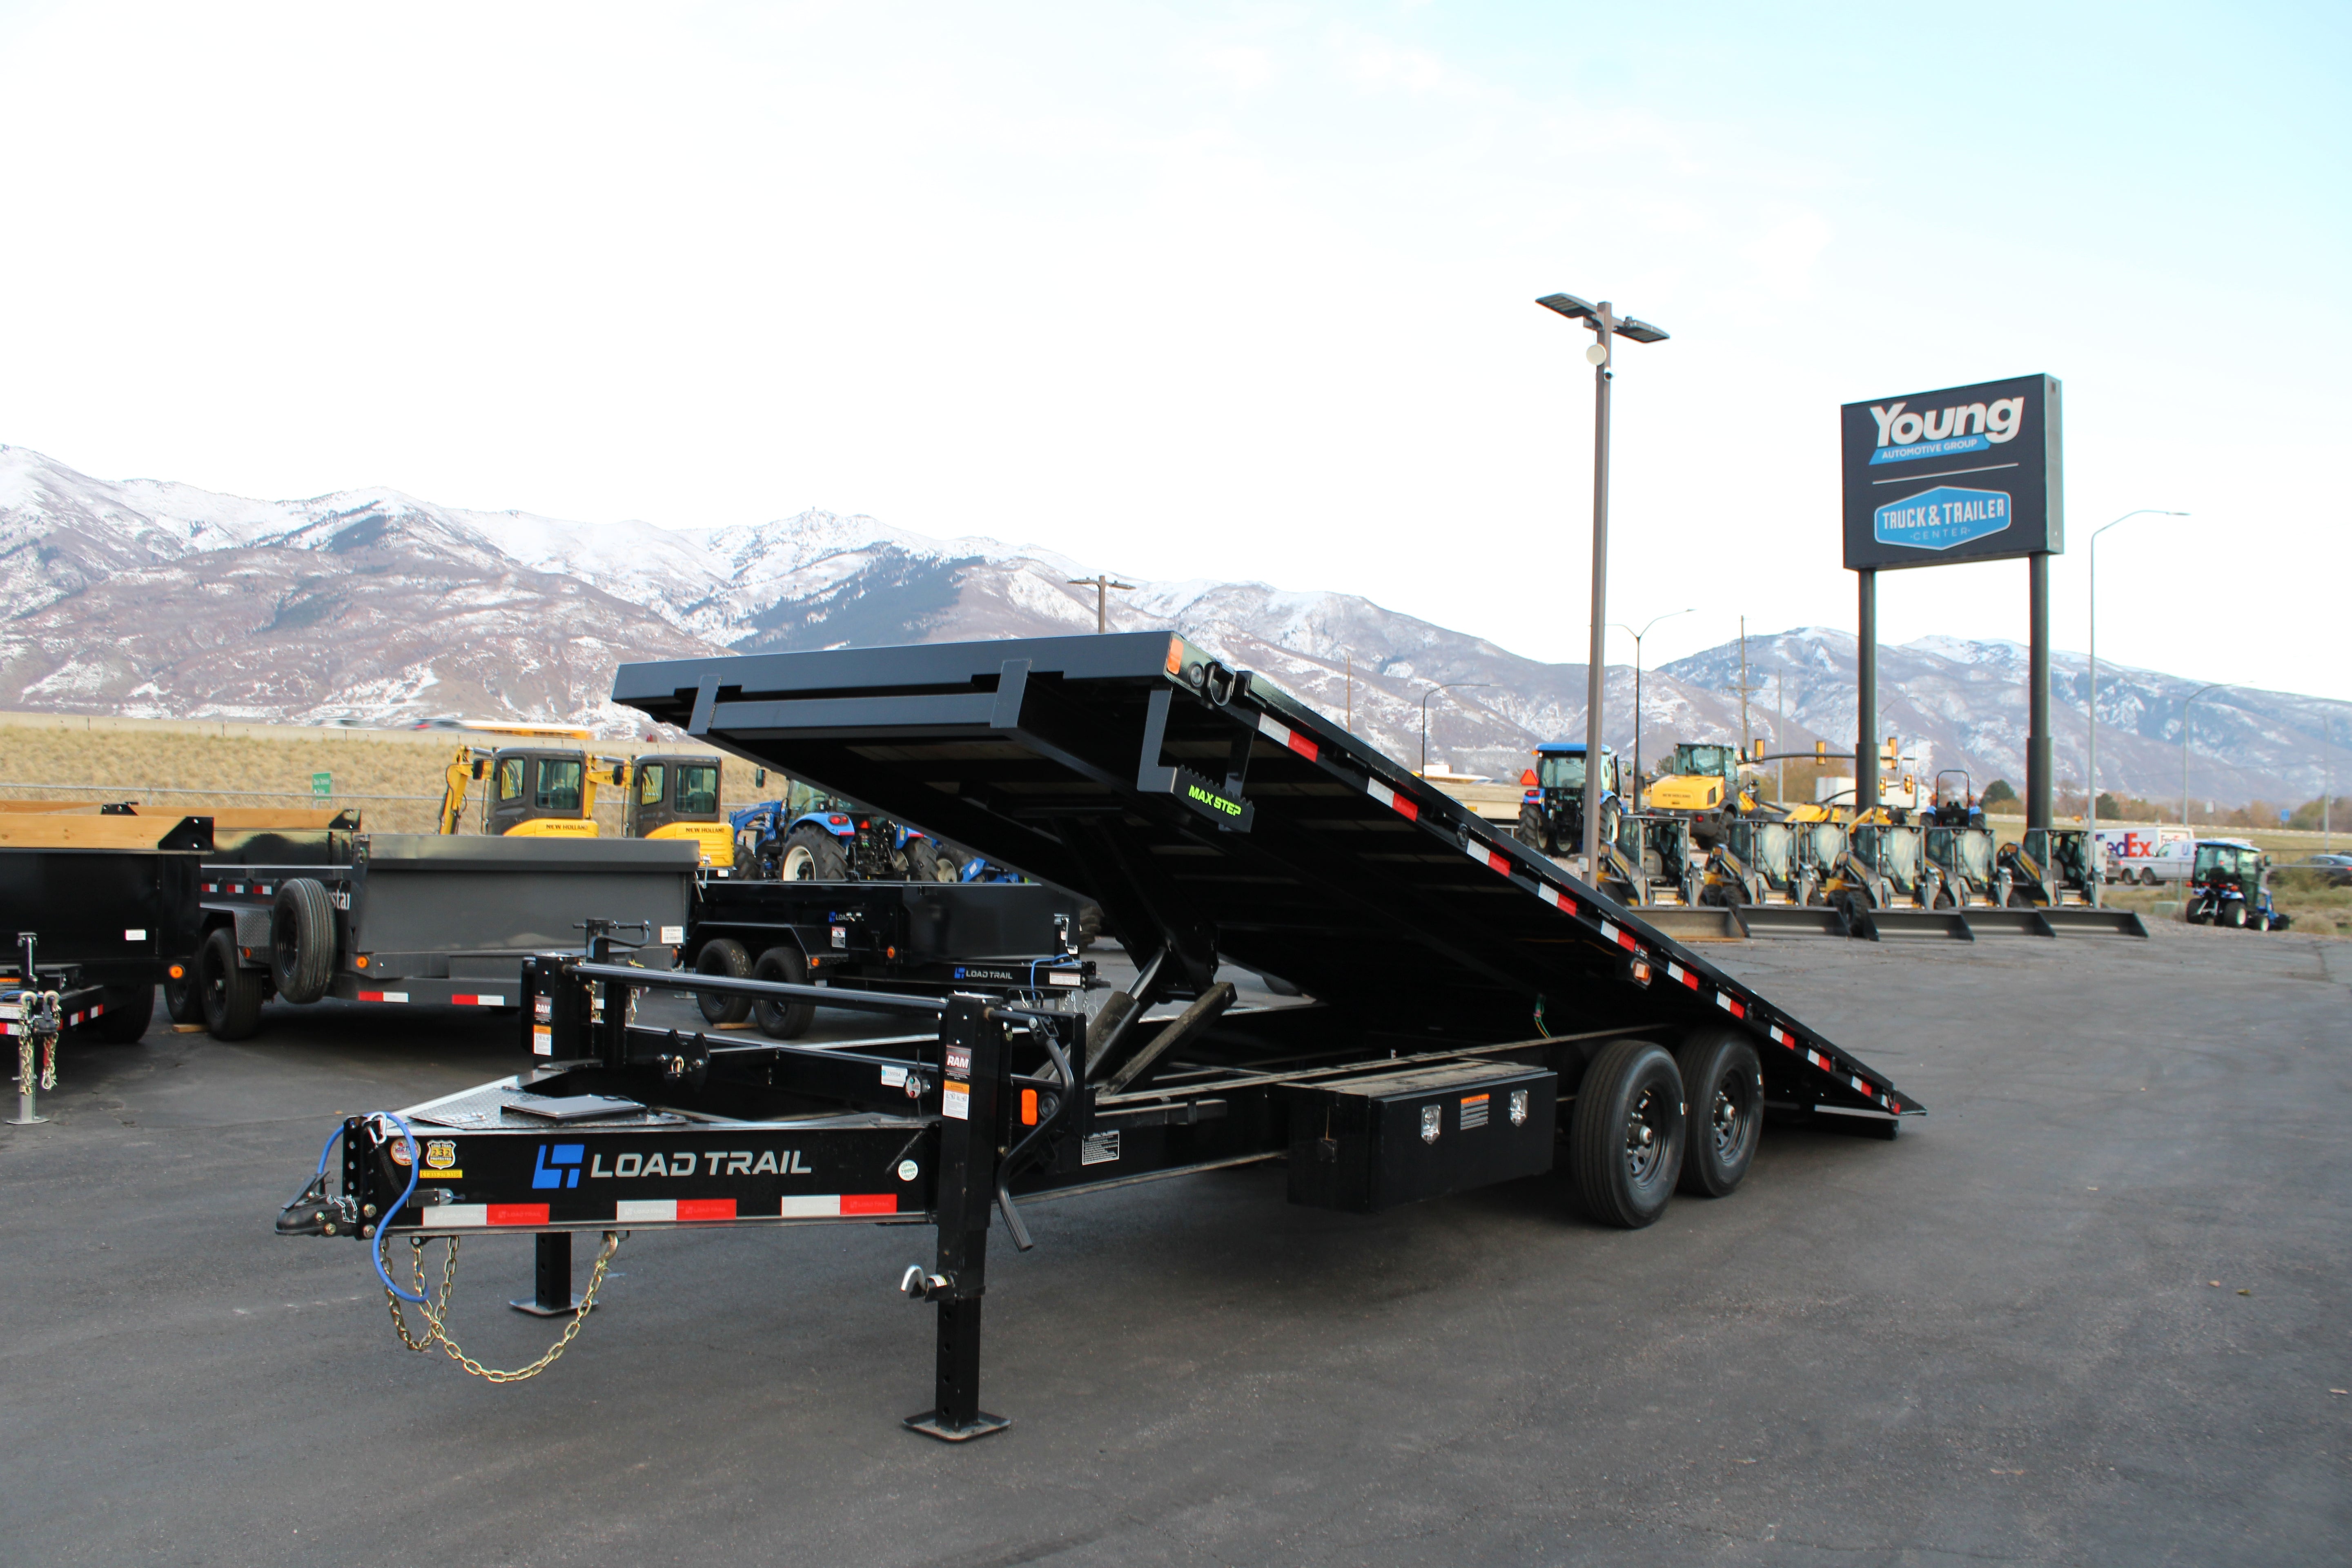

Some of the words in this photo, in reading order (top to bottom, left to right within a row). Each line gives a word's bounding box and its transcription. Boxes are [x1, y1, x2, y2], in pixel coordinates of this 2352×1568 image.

[1869, 396, 2025, 448] Young
[1882, 443, 1942, 459] AUTOMOTIVE
[1944, 438, 1978, 450] GROUP
[1882, 506, 1927, 530] TRUCK
[1928, 505, 1940, 526] &
[1943, 498, 2005, 525] TRAILER
[1913, 527, 1968, 541] CENTER
[1188, 784, 1214, 806] MAX
[1213, 796, 1242, 816] STEP
[966, 969, 988, 978] LOAD
[990, 971, 1013, 979] TRAIL
[536, 1003, 551, 1014] RAM
[947, 1054, 969, 1069] RAM
[432, 1149, 450, 1157] 232
[590, 1152, 697, 1178] LOAD
[704, 1150, 812, 1175] TRAIL
